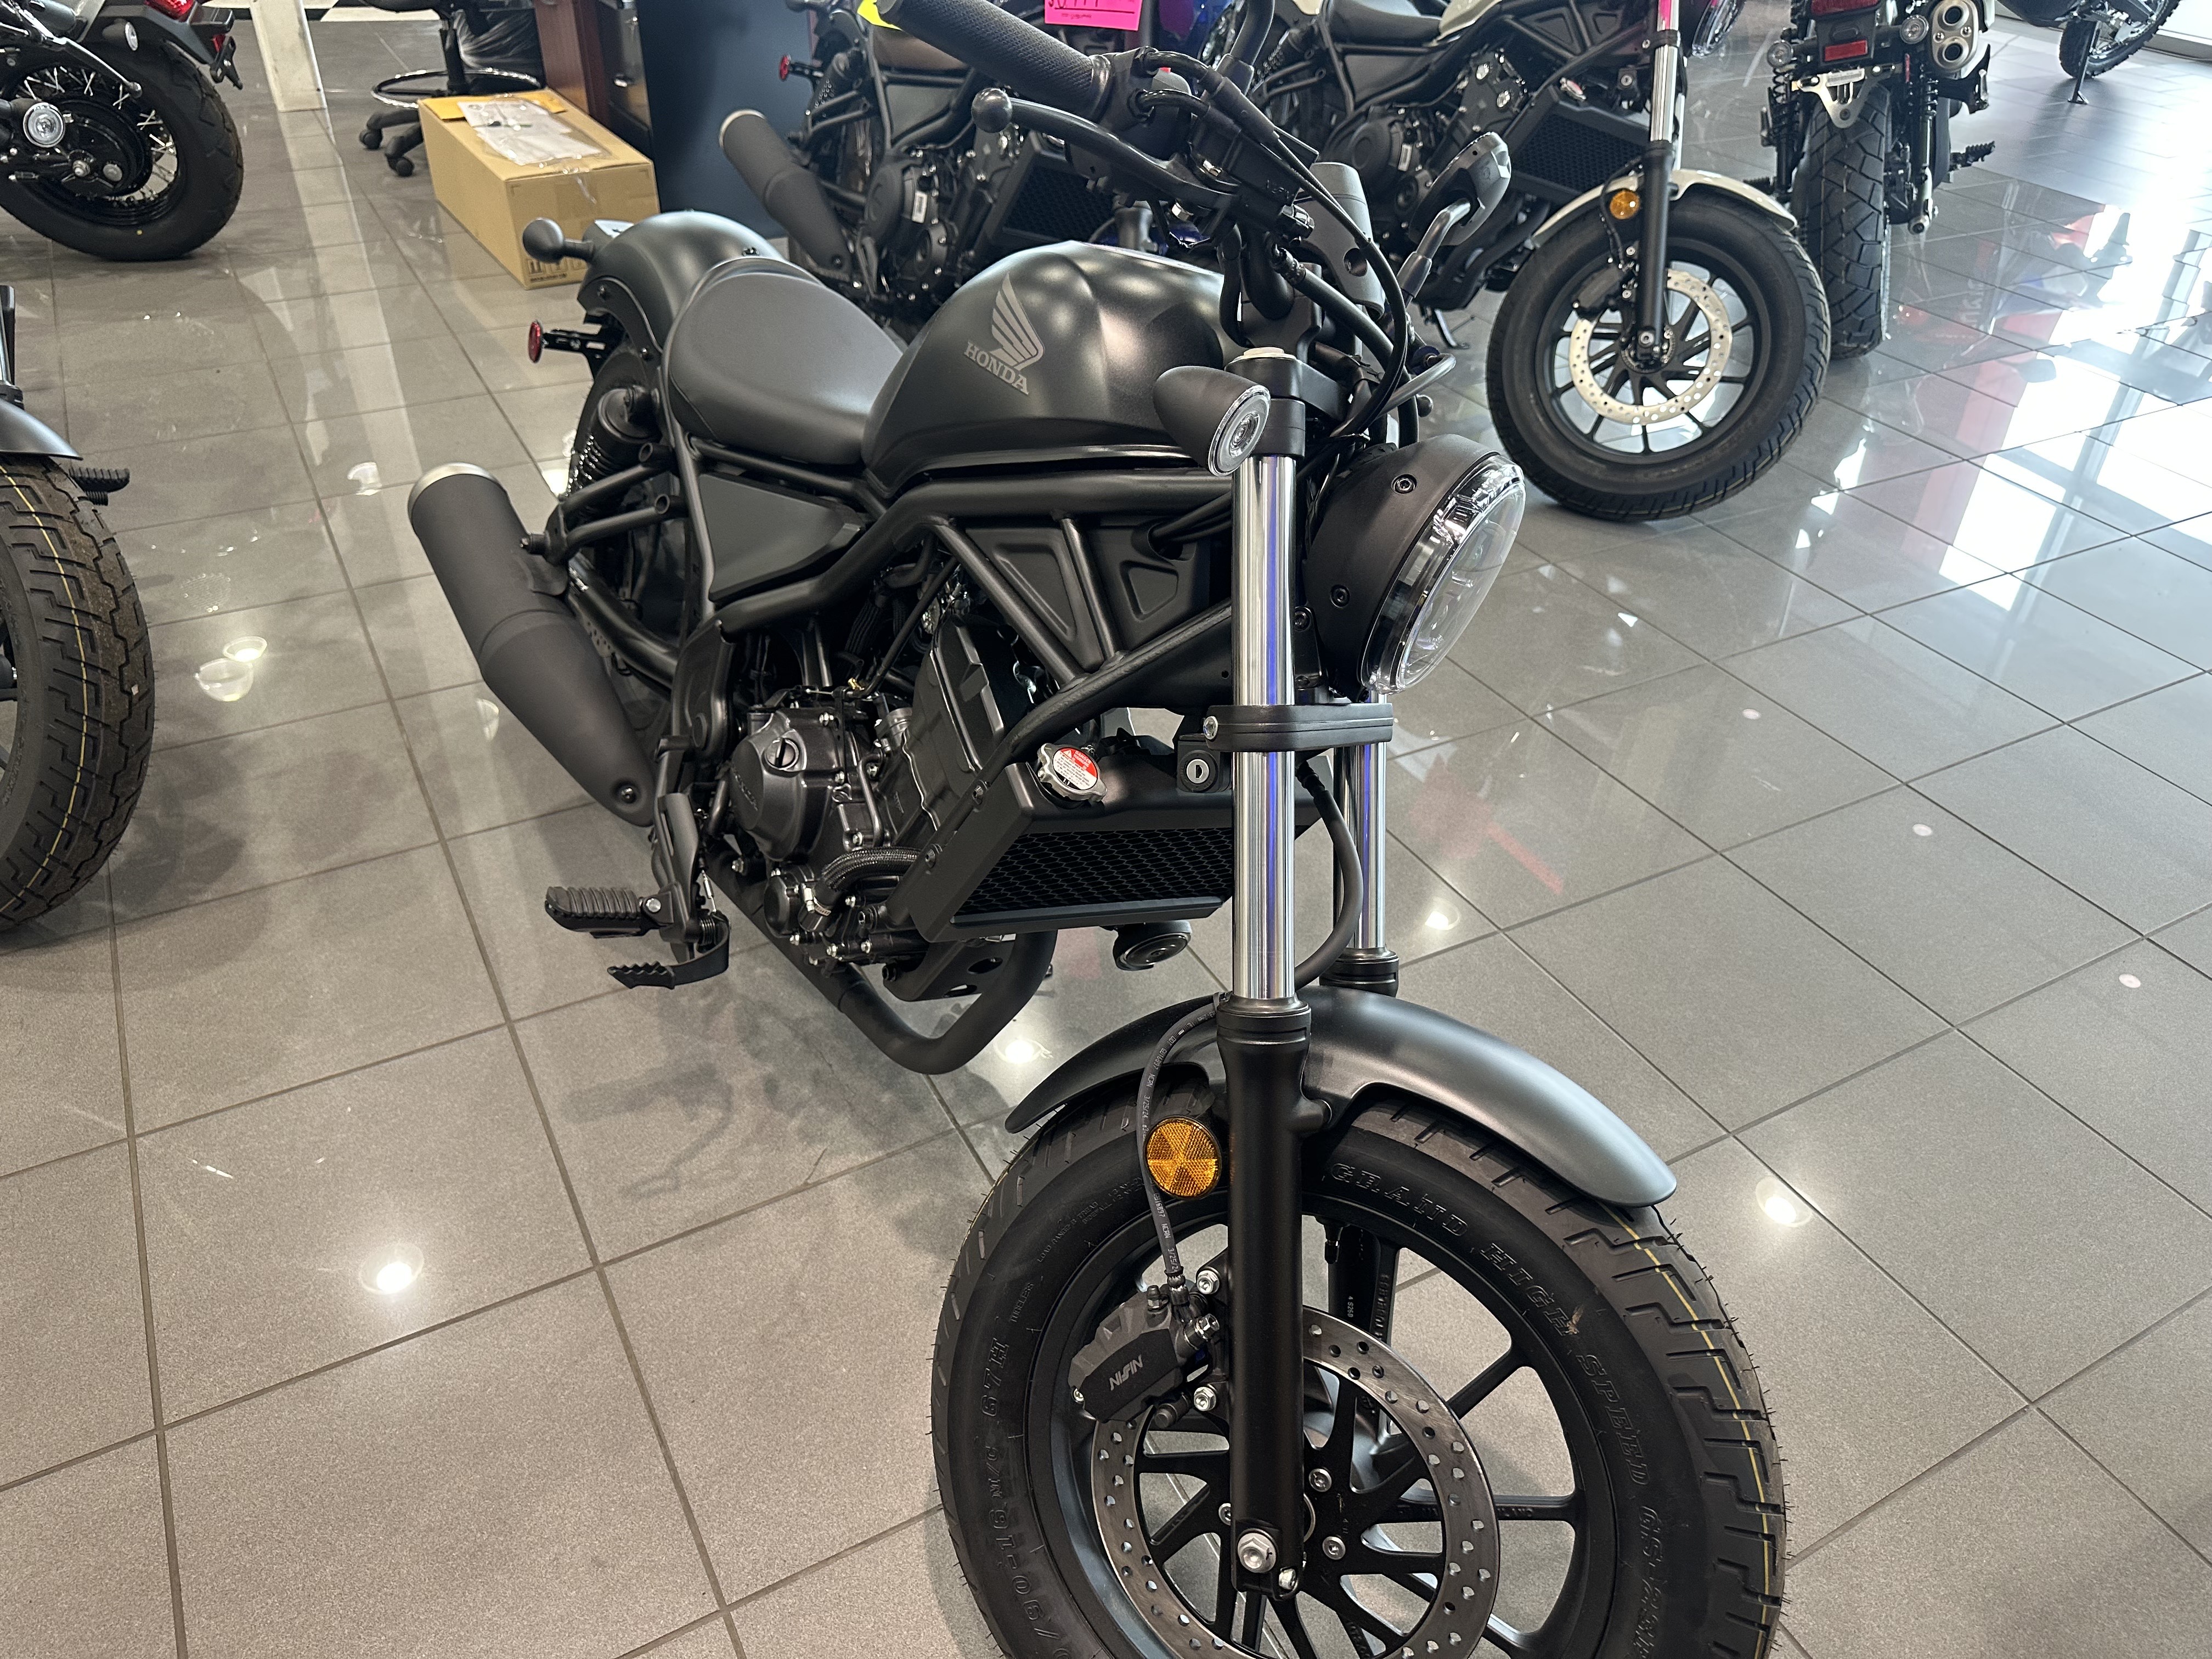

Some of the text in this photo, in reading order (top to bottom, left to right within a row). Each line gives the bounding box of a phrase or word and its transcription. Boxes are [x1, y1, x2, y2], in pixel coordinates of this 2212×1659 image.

[964, 340, 1029, 395] HONDA
[1037, 1245, 1052, 1263] LOAD
[1052, 1223, 1070, 1244] RANGE
[1077, 1201, 1098, 1219] TREAD
[1331, 1163, 1469, 1237] GRAND
[1010, 1282, 1035, 1323] TUBELESS
[1480, 1243, 1579, 1336] HIGH
[981, 1337, 1009, 1417] 67H
[1575, 1354, 1649, 1486] SPEED
[986, 1444, 1003, 1499] M/C
